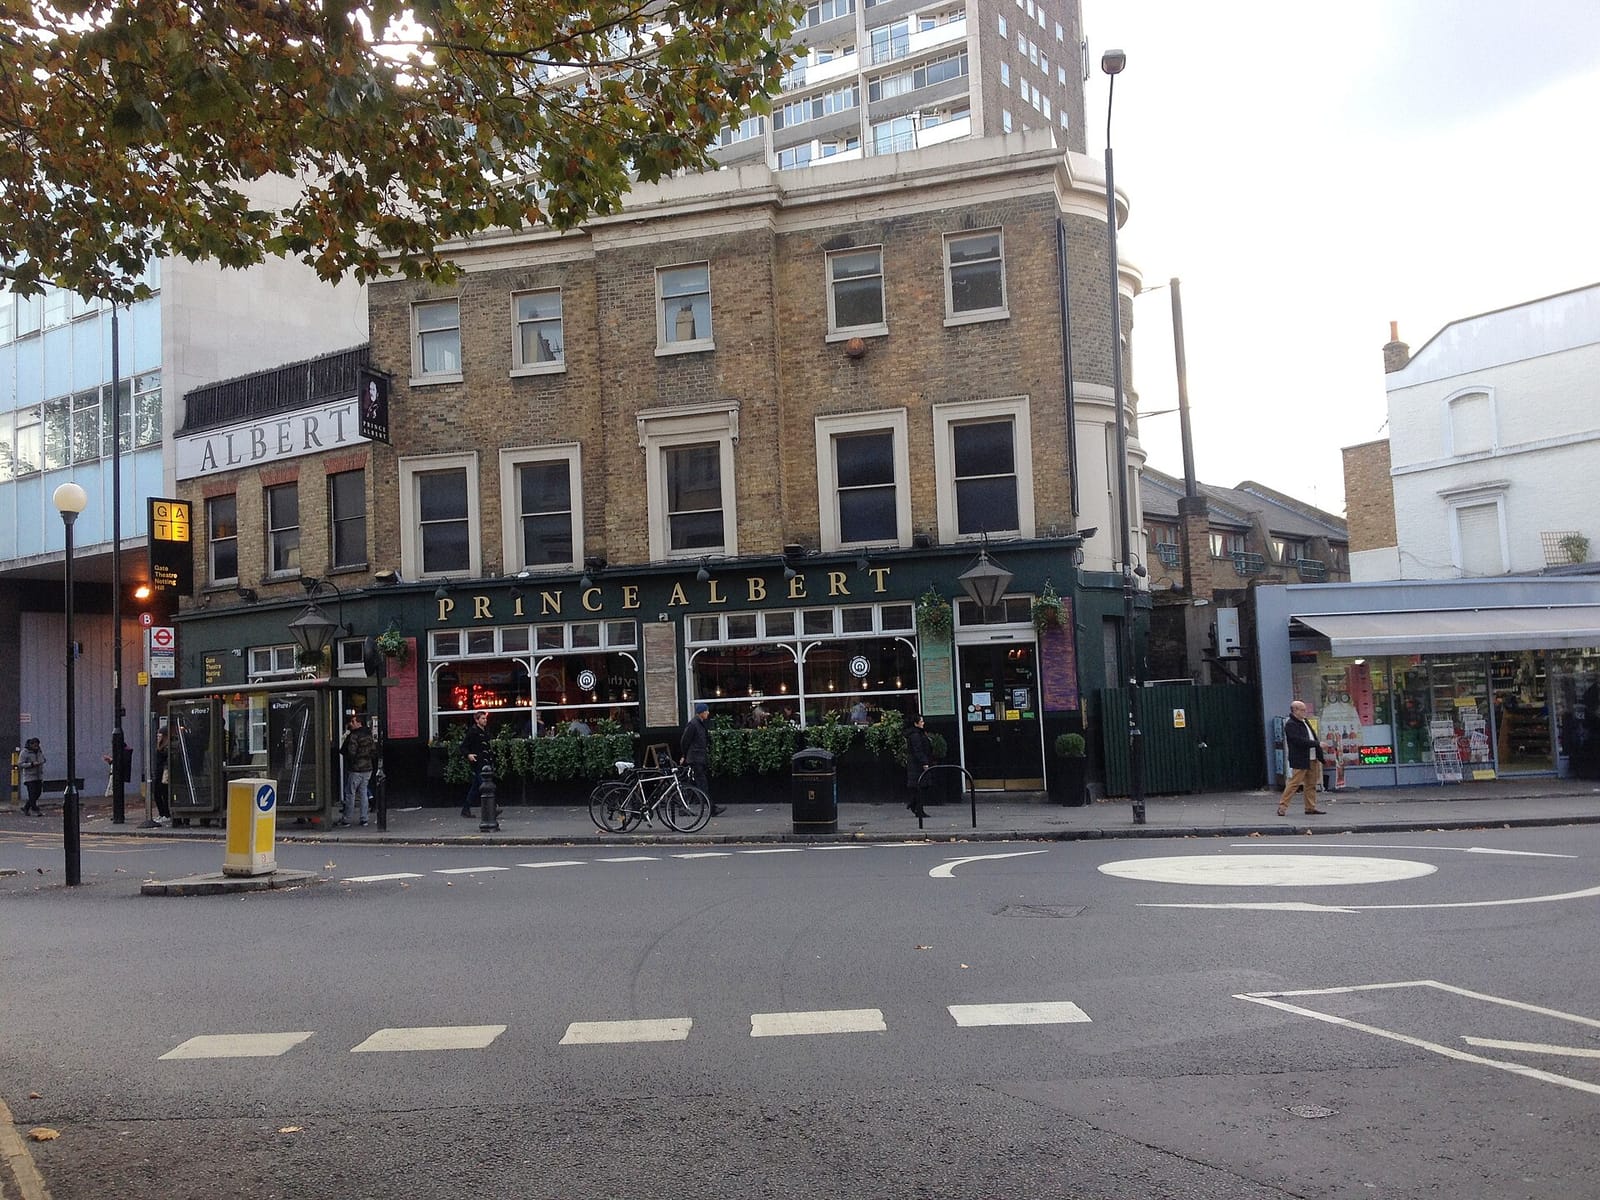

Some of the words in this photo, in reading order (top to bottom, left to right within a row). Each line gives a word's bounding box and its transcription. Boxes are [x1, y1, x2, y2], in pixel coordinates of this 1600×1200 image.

[363, 421, 386, 432] PRINCE
[200, 406, 350, 471] ALBERT
[363, 428, 386, 439] ALBERT
[154, 571, 178, 579] Theatre
[437, 585, 641, 621] PRINCE
[667, 567, 891, 606] ALBERT
[143, 614, 151, 625] B
